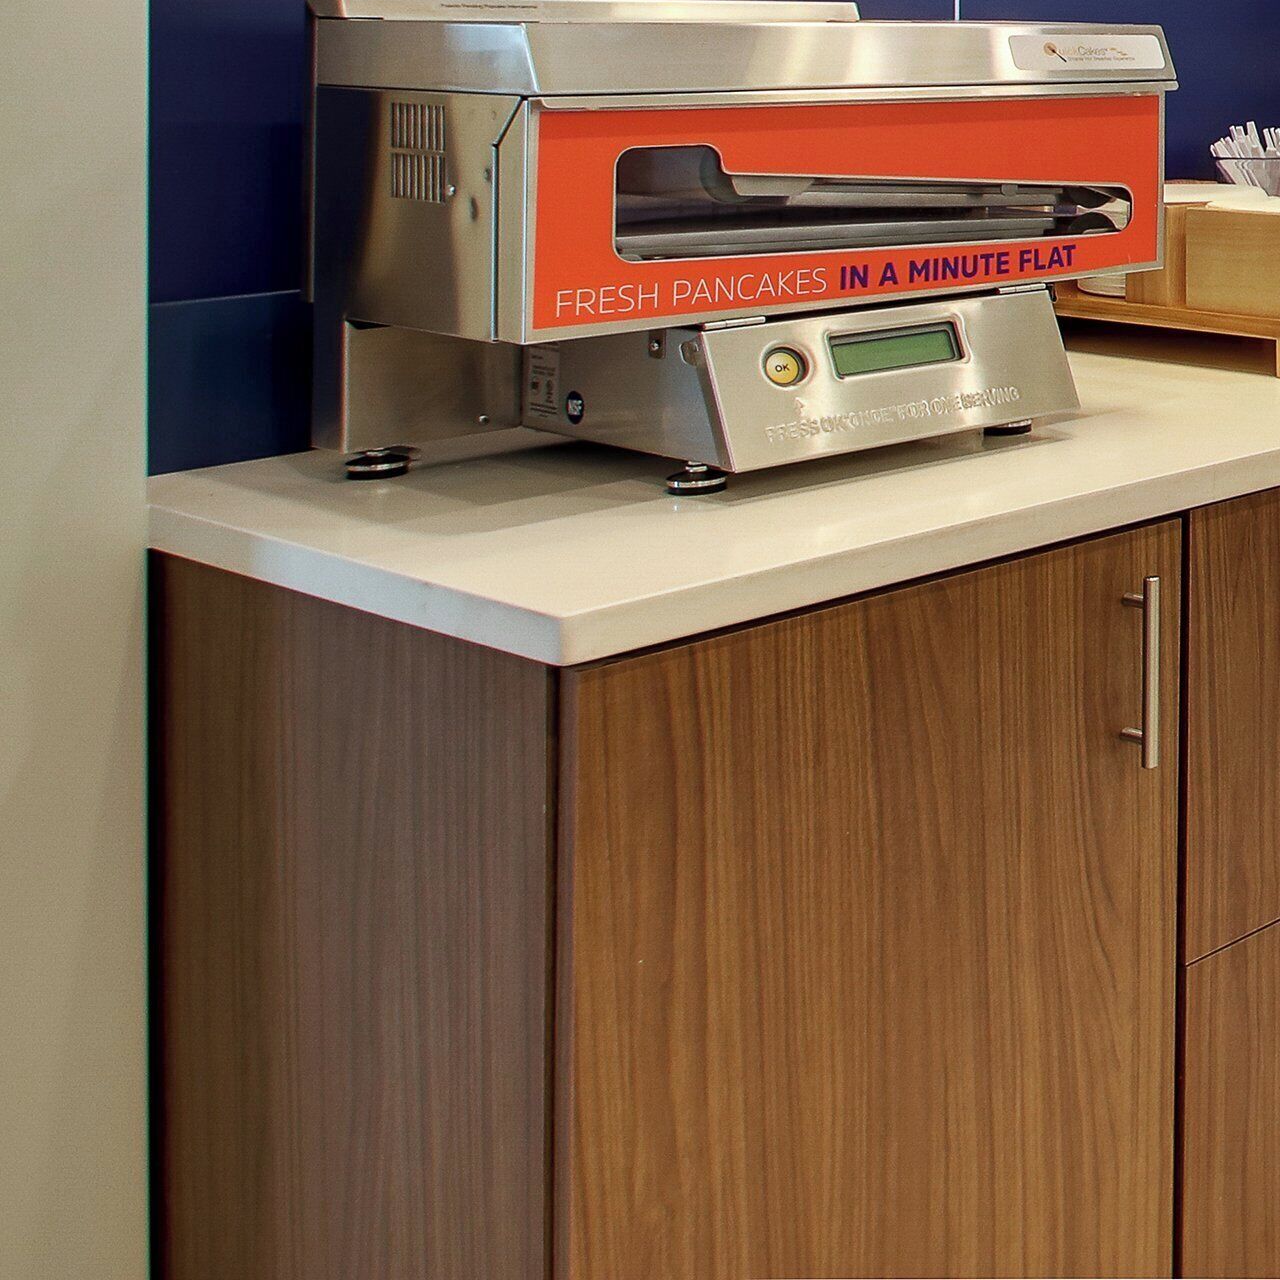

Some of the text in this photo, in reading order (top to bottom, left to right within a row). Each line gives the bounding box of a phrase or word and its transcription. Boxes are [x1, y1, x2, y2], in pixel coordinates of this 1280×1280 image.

[556, 244, 1077, 318] FRESH PANCAKES IN A MINUTE FLAT
[774, 362, 790, 373] OK
